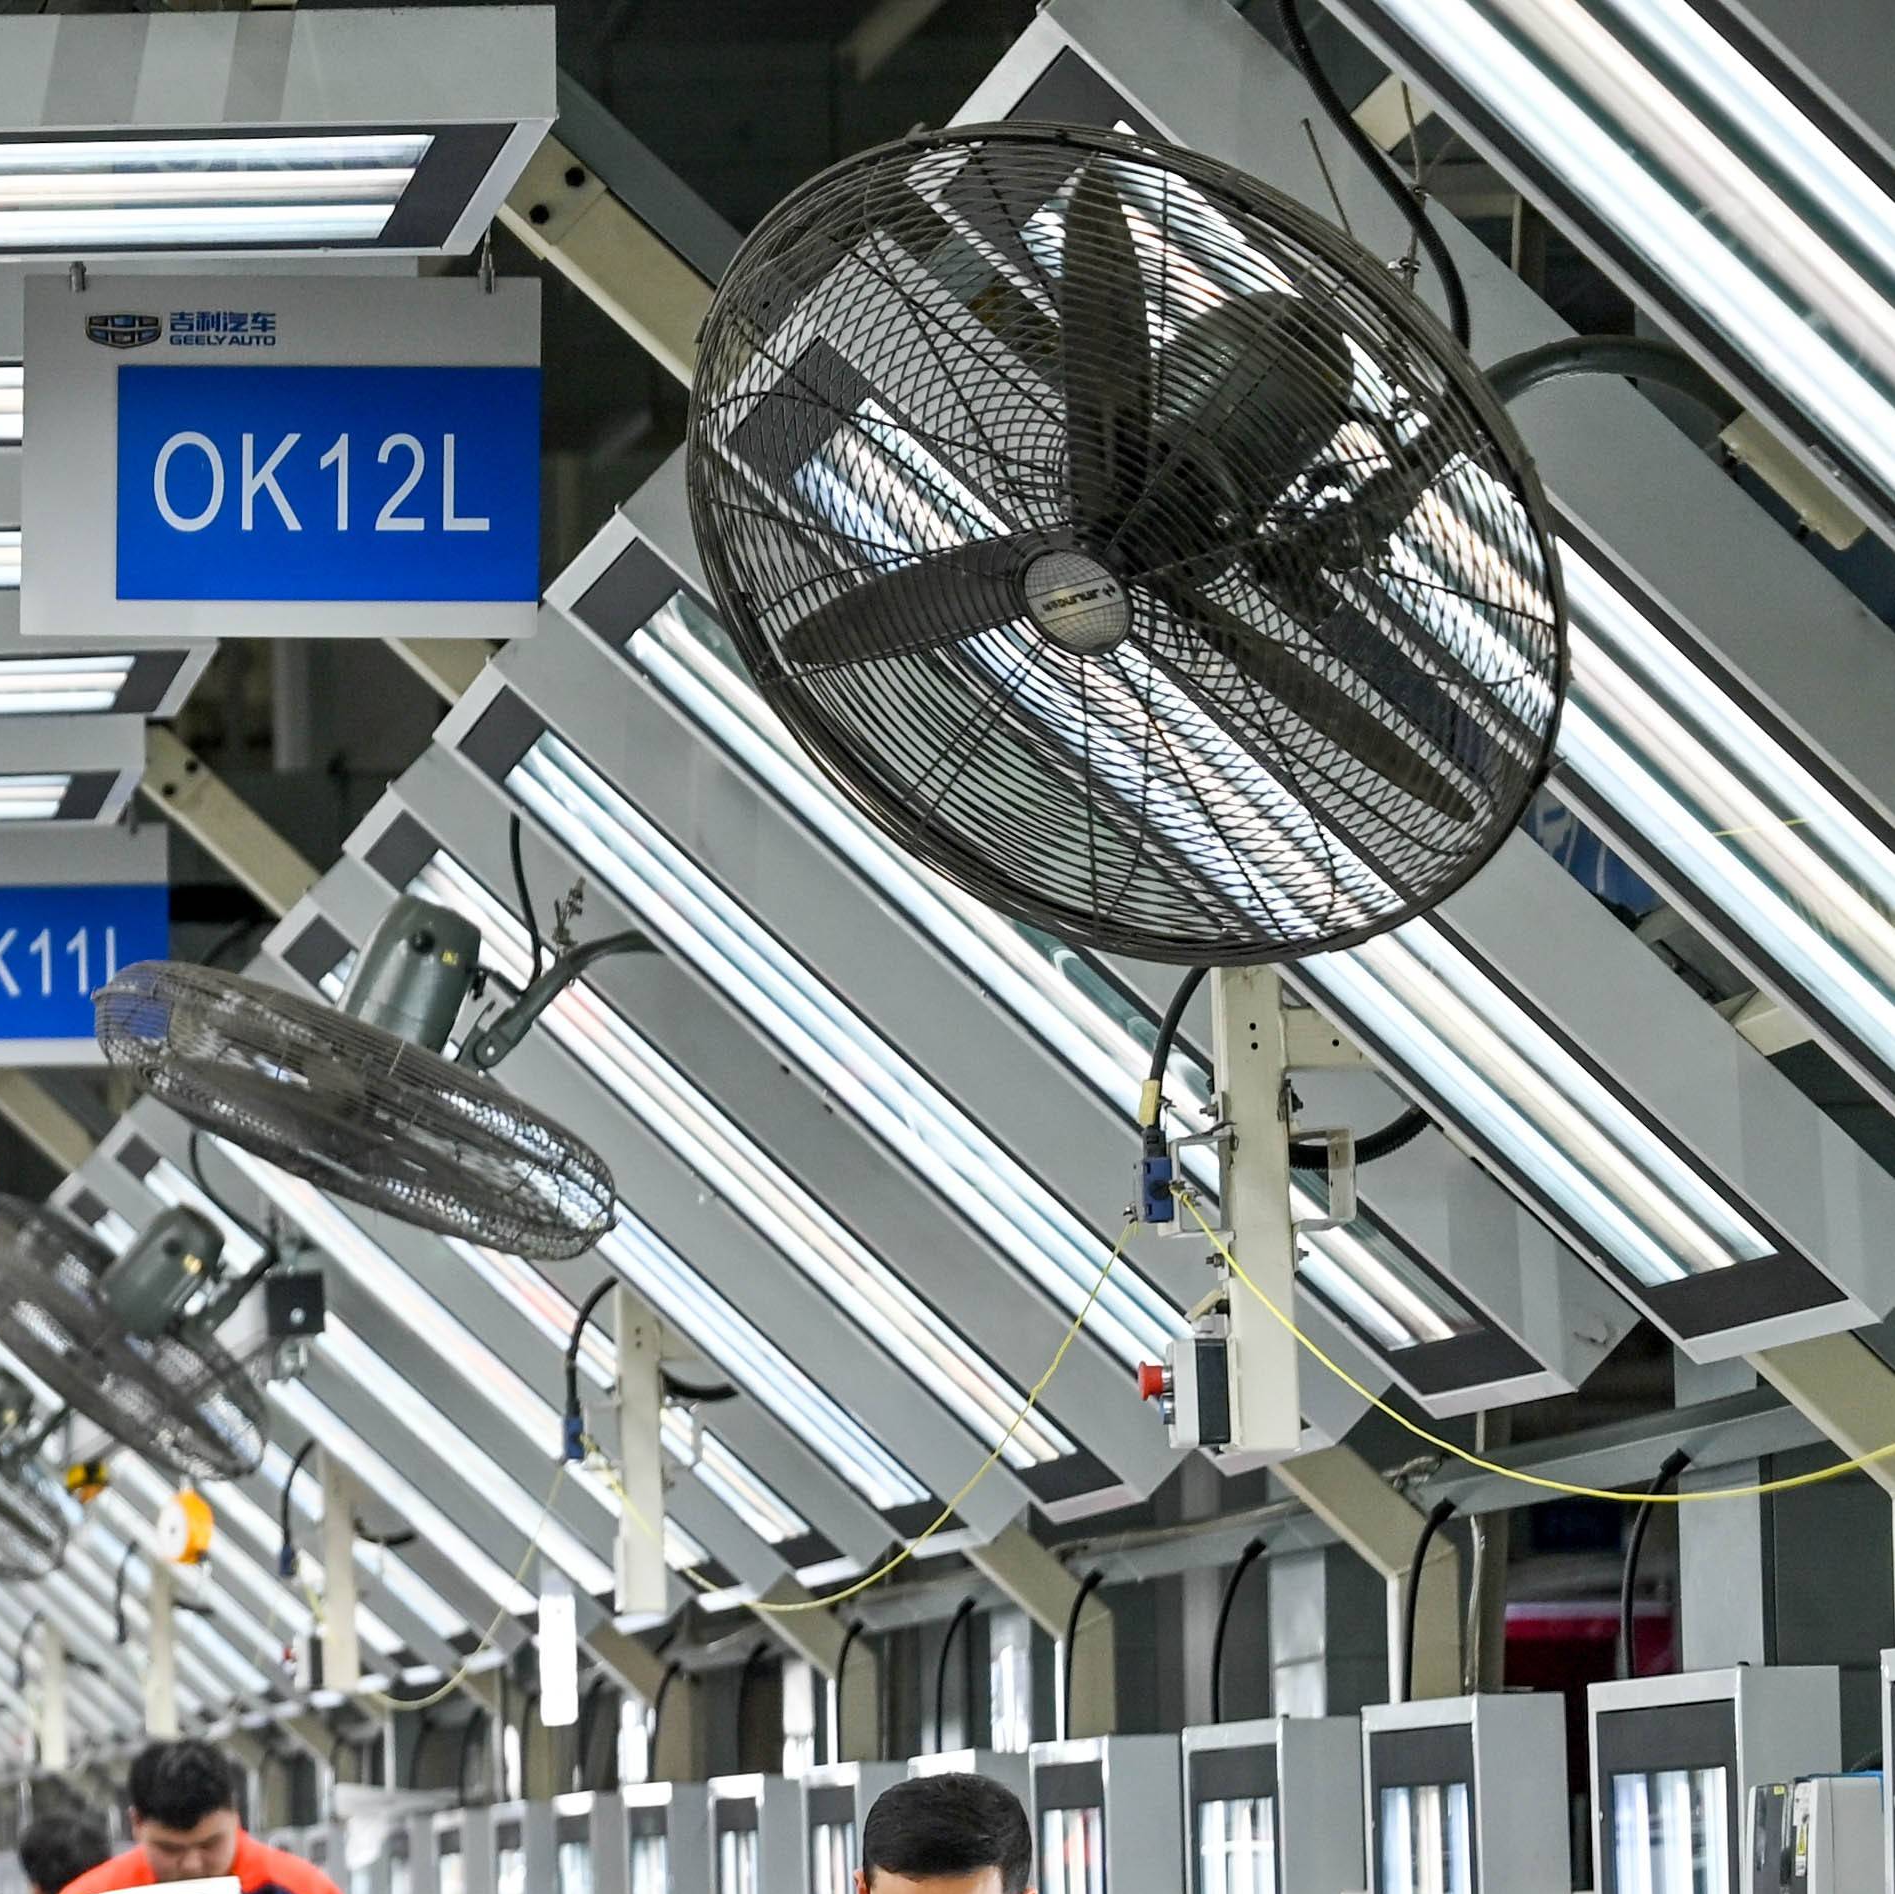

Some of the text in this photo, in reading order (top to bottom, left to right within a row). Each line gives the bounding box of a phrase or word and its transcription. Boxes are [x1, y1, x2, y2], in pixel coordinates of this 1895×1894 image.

[170, 311, 276, 333] 吉利汽车
[170, 335, 276, 346] GEELY AUTO
[152, 430, 491, 533] OK12L
